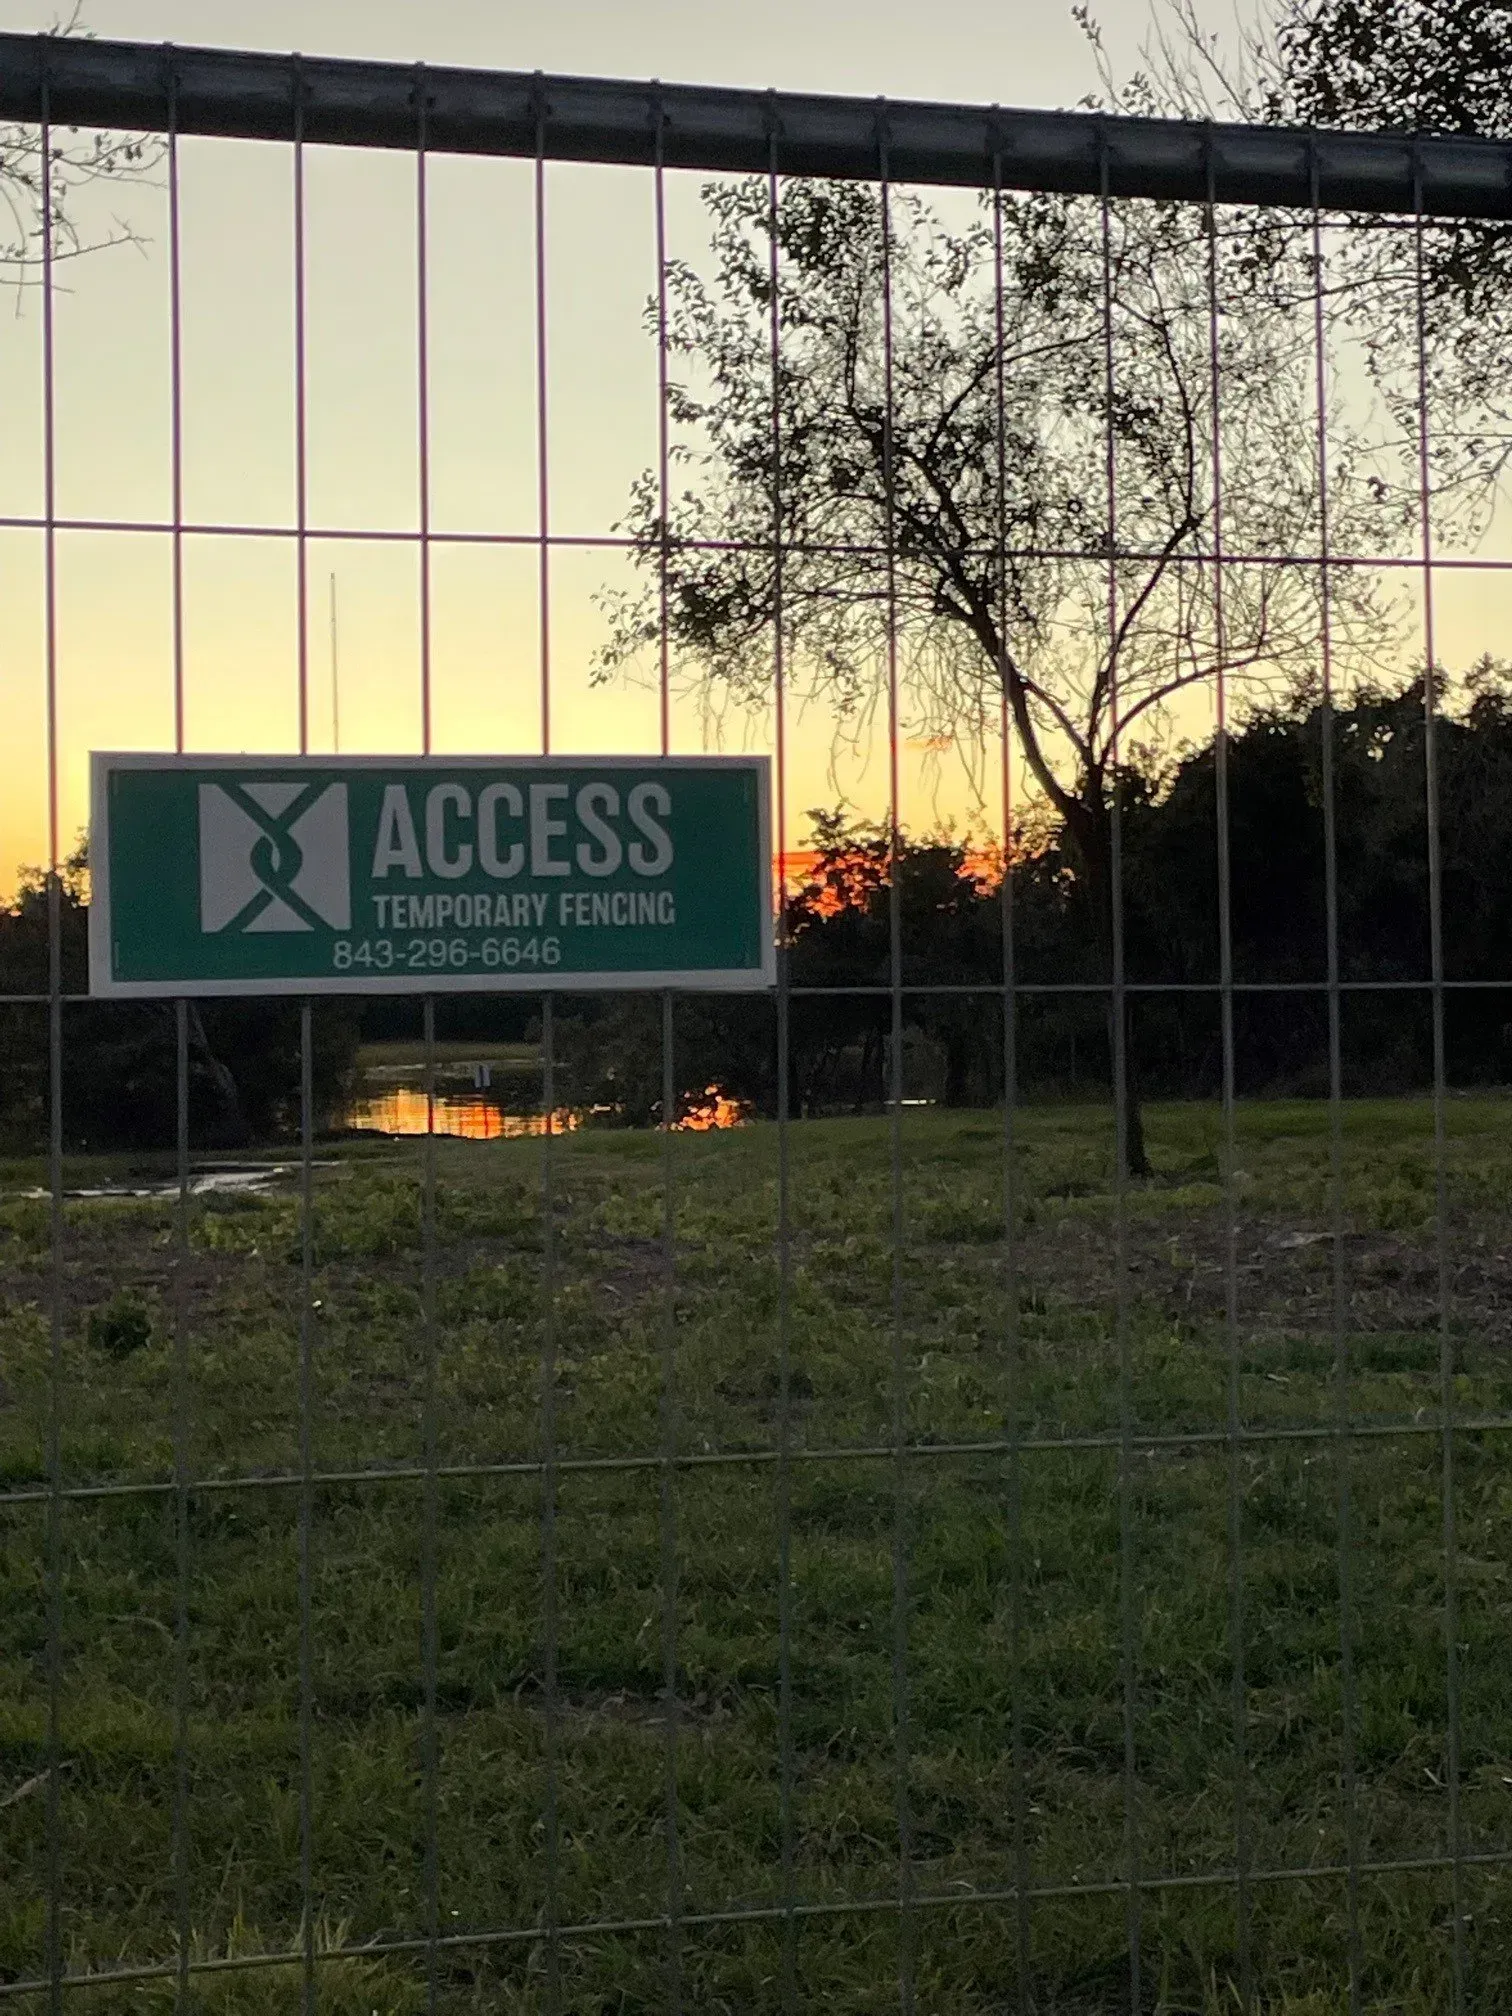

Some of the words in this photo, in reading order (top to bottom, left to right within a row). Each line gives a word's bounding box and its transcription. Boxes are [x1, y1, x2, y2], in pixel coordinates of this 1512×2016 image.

[371, 782, 675, 879] ACCESS
[371, 893, 548, 929] TEMPORARY
[558, 891, 676, 926] FENCING
[333, 938, 561, 969] 843-296-6646
